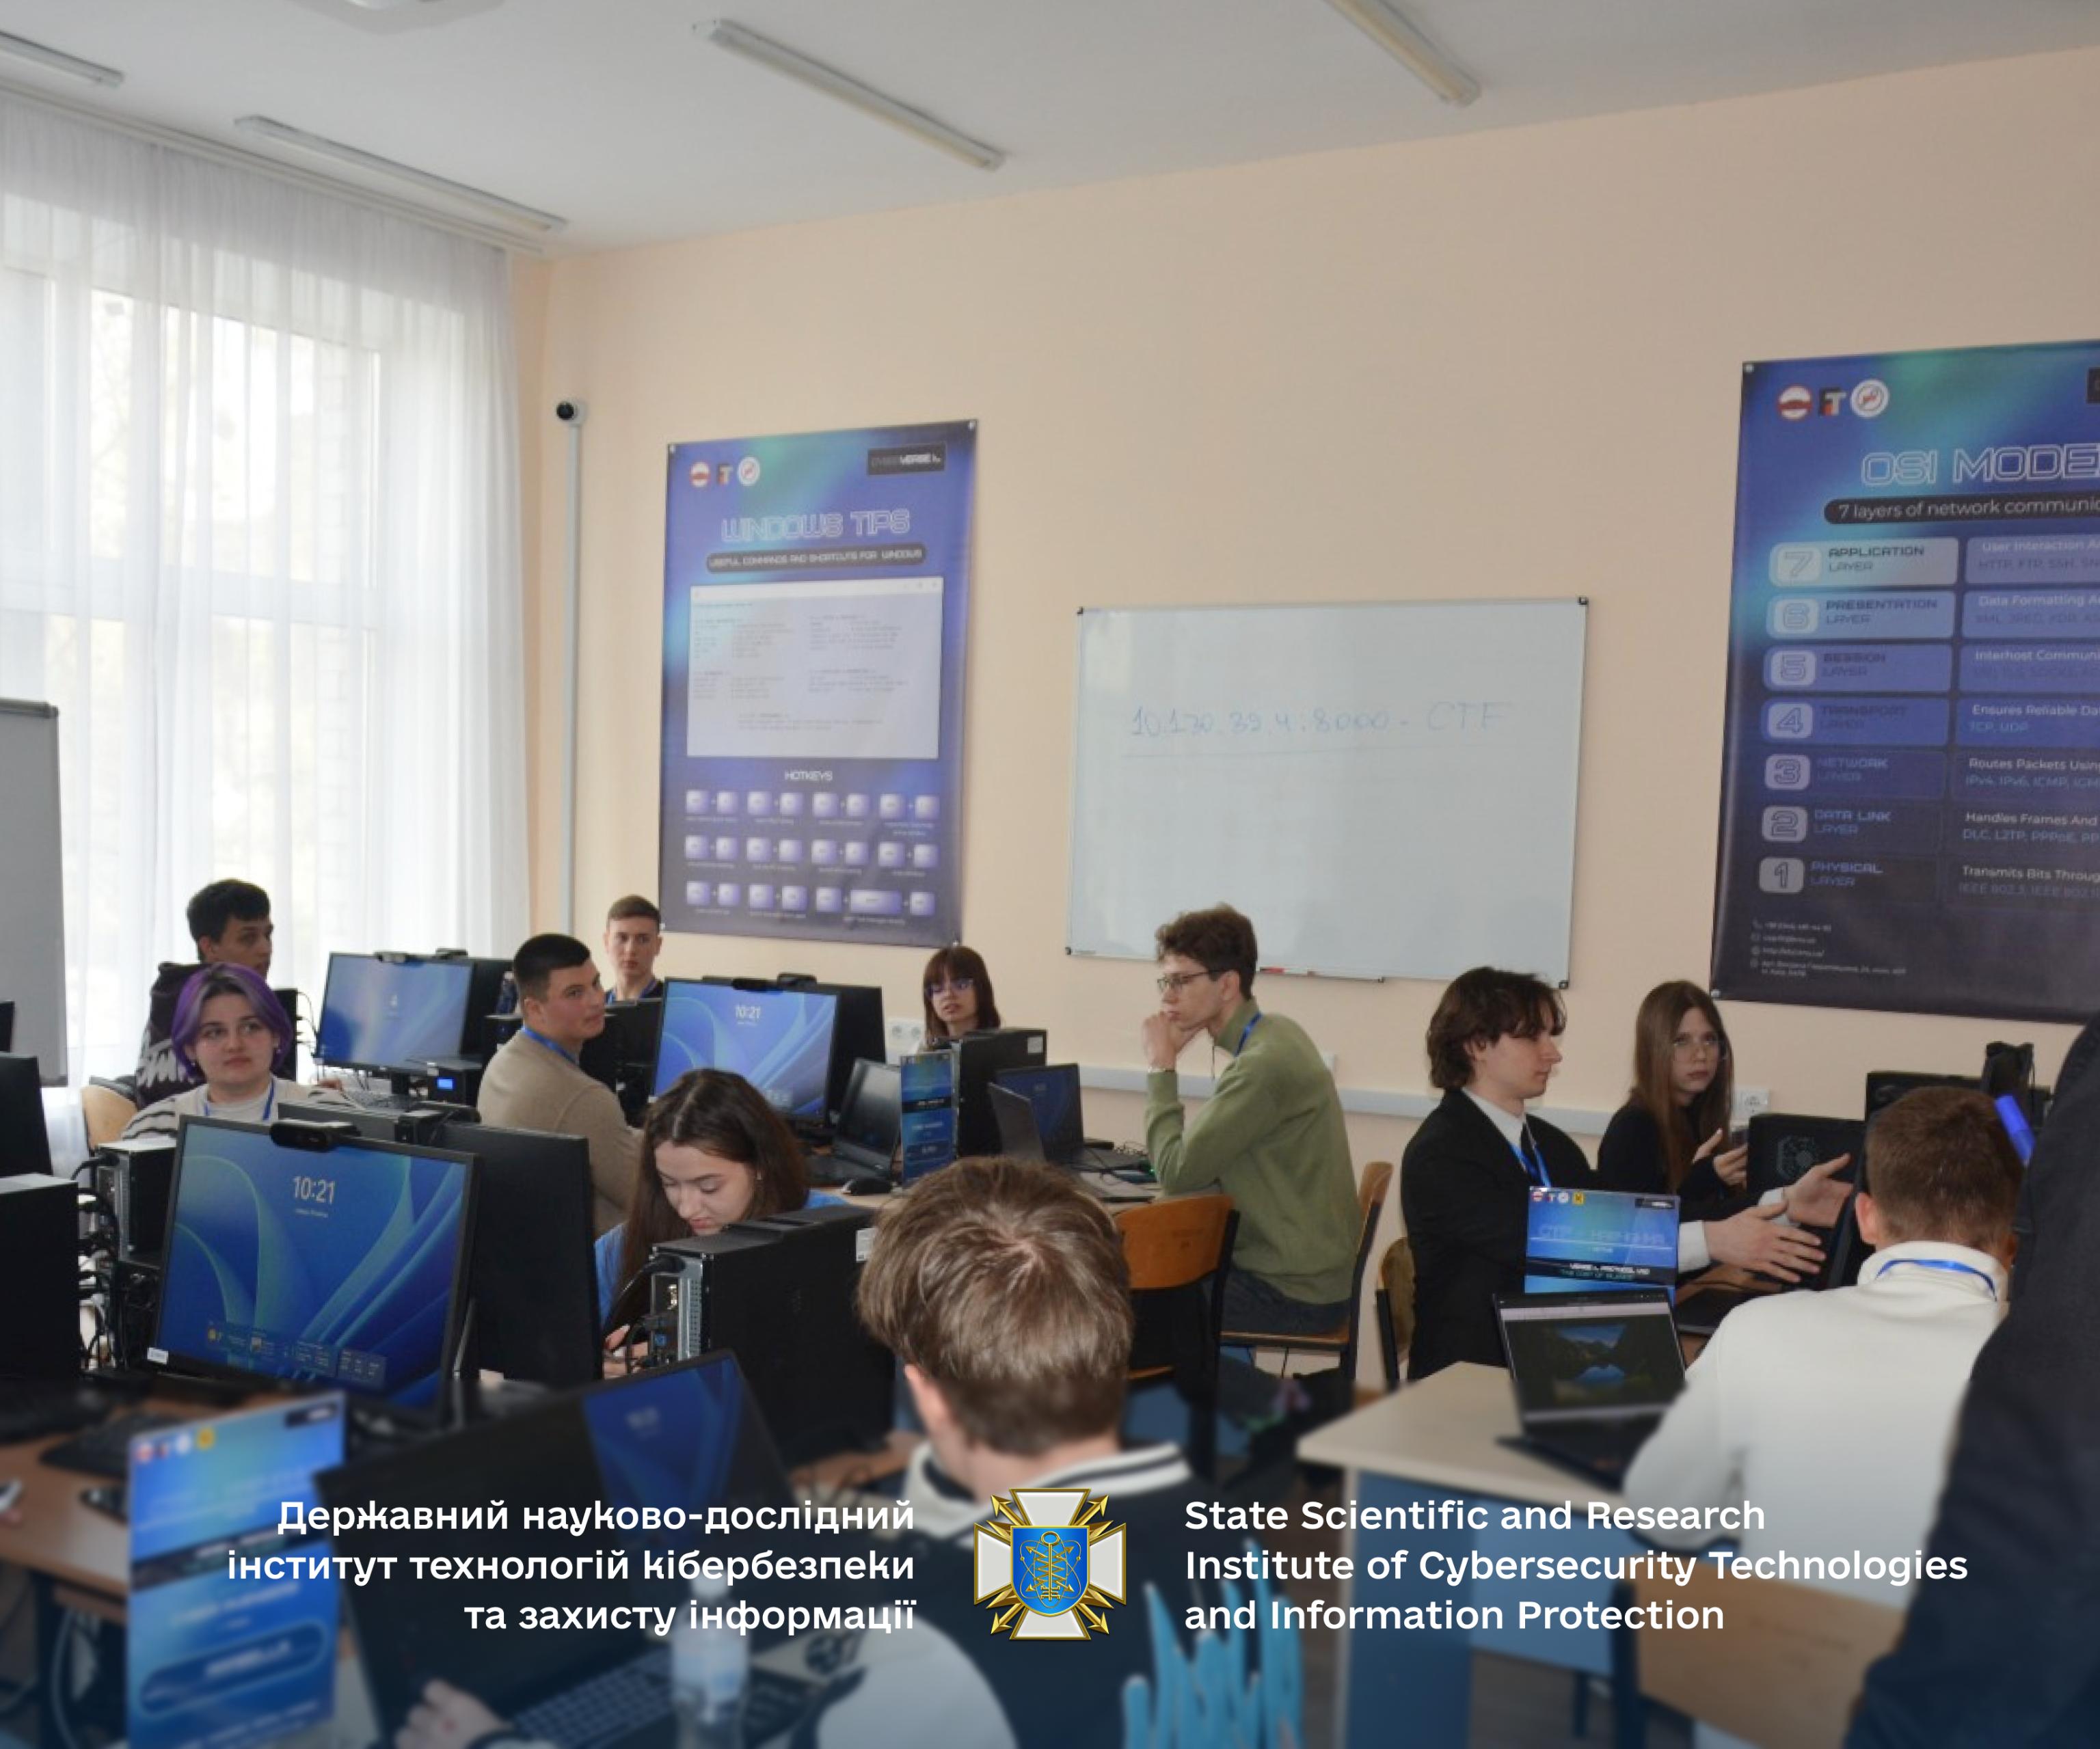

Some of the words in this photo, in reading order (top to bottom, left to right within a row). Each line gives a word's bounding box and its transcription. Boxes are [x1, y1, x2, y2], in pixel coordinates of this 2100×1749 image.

[1861, 449, 1938, 487] OSI
[1953, 443, 2100, 483] MODE
[1839, 505, 1849, 518] 7
[1854, 504, 1902, 520] layers
[1906, 502, 1922, 516] of
[1928, 499, 2000, 516] network
[721, 513, 844, 542] WINDOWS
[850, 509, 911, 535] TIPS
[1829, 546, 1924, 558] APPLICATION
[1783, 551, 1813, 577] 7
[1829, 560, 1873, 572] LAYER
[1826, 599, 1938, 610] PRESENTATION
[1978, 596, 2008, 608] Data
[2012, 594, 2084, 608] Formatting
[1783, 602, 1809, 629] 6
[1975, 651, 2033, 662] Interhost
[1780, 653, 1806, 681] 5
[1972, 704, 2022, 716] Ensures
[2026, 705, 2077, 716] Reliable
[1777, 707, 1803, 733] 4
[1818, 757, 1889, 769] NETWORK
[1969, 758, 2013, 770] Routes
[2017, 757, 2067, 770] Packets
[784, 770, 833, 782] HOTKEYS
[1774, 758, 1801, 785] 3
[1814, 809, 1853, 821] DATA
[1857, 811, 1892, 822] LINK
[1965, 812, 2017, 824] Handles
[2020, 813, 2067, 826] Frames
[2071, 815, 2098, 826] And
[1771, 810, 1799, 837] 2
[1814, 824, 1859, 835] LAYER
[1810, 861, 1883, 874] PHYSICAL
[1962, 865, 2024, 880] Transmits
[2027, 869, 2051, 880] Bits
[1774, 861, 1789, 889] 1
[1811, 876, 1856, 887] LAYER
[735, 1004, 761, 1019] 10:21
[293, 1176, 336, 1205] 10:21
